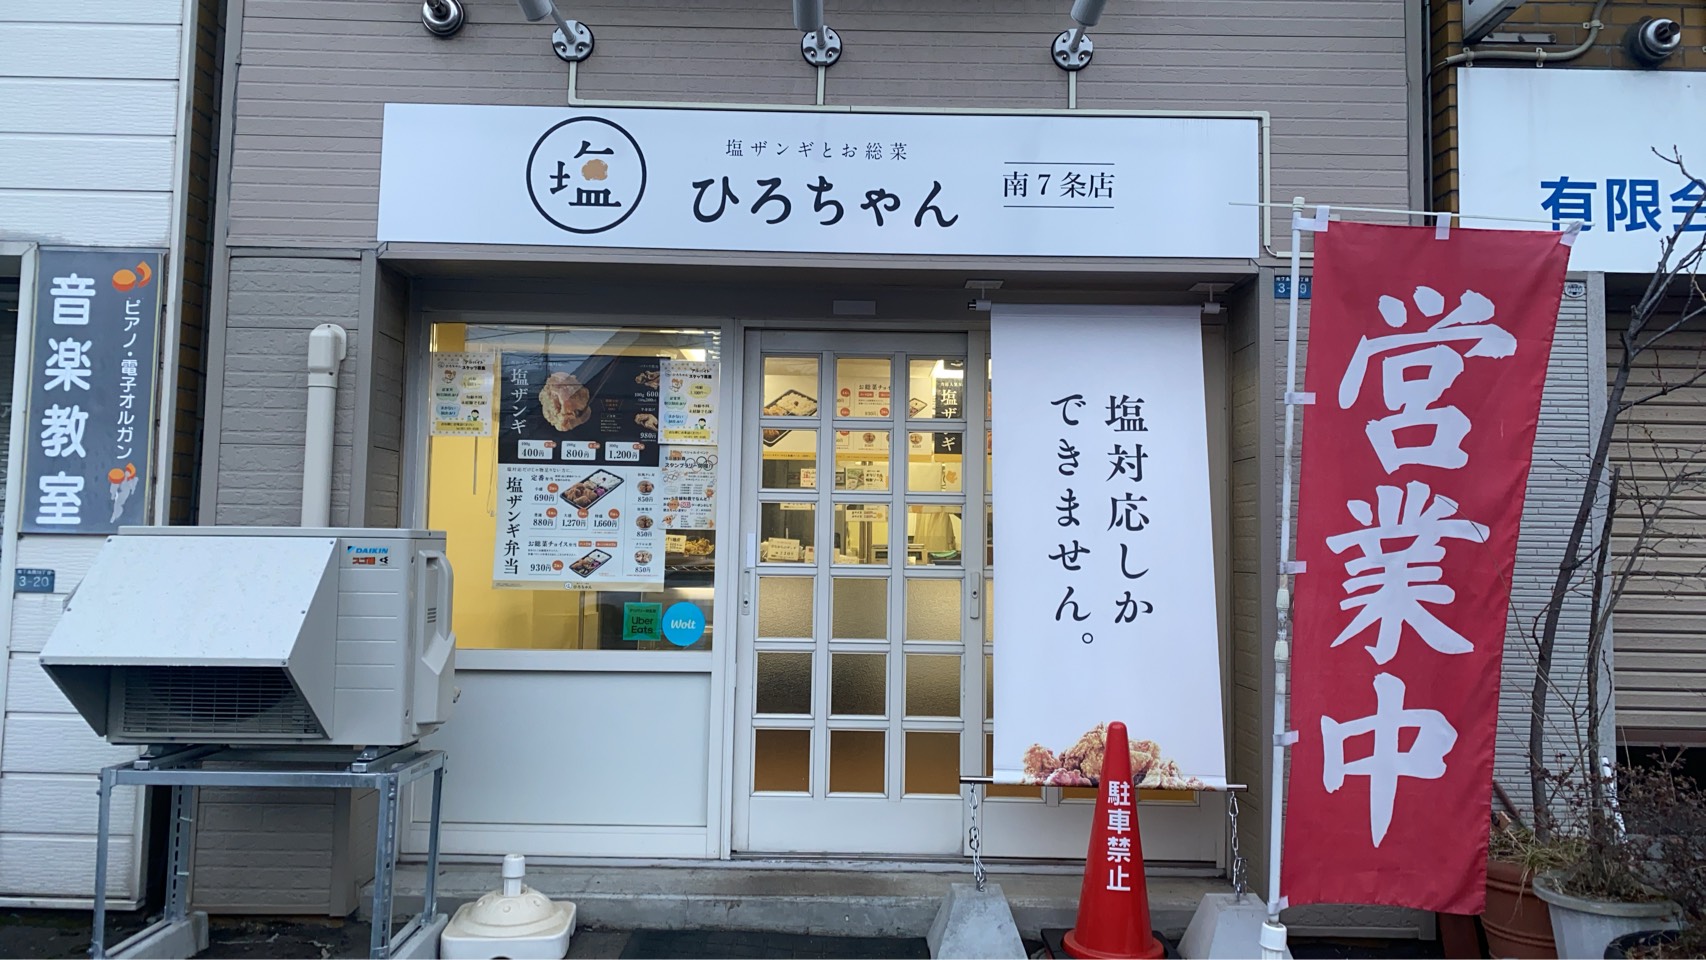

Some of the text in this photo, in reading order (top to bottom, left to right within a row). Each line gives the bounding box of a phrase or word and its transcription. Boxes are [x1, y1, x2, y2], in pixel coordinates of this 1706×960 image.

[725, 139, 908, 161] 塩ザンギとお総菜
[549, 140, 622, 207] 塩
[1002, 171, 1116, 199] 南7条店
[692, 175, 959, 228] ひろちゃん
[1540, 176, 1706, 233] 有限会
[116, 298, 142, 460] ピアノ・電子オルガン
[35, 272, 96, 526] 音楽教室
[510, 368, 529, 435] 塩ザンギ
[940, 389, 958, 452] 塩ザギ
[521, 448, 545, 457] 400円
[566, 449, 590, 458] 800円
[608, 450, 638, 460] 1,200円
[533, 494, 555, 502] 690円
[1105, 394, 1154, 624] 塩対応しか
[503, 476, 524, 576] 塩ザンギ弁当
[532, 519, 554, 527] 880円
[561, 520, 587, 528] 1,270円
[593, 520, 618, 528] 1,660円
[1048, 393, 1094, 645] できません。
[530, 562, 552, 572] 930円
[1321, 285, 1518, 848] 営業中
[18, 575, 50, 588] 3-20
[631, 616, 654, 625] Uber
[631, 625, 654, 634] Eats
[670, 619, 697, 630] Wolt
[1106, 780, 1131, 892] 駐車禁止
